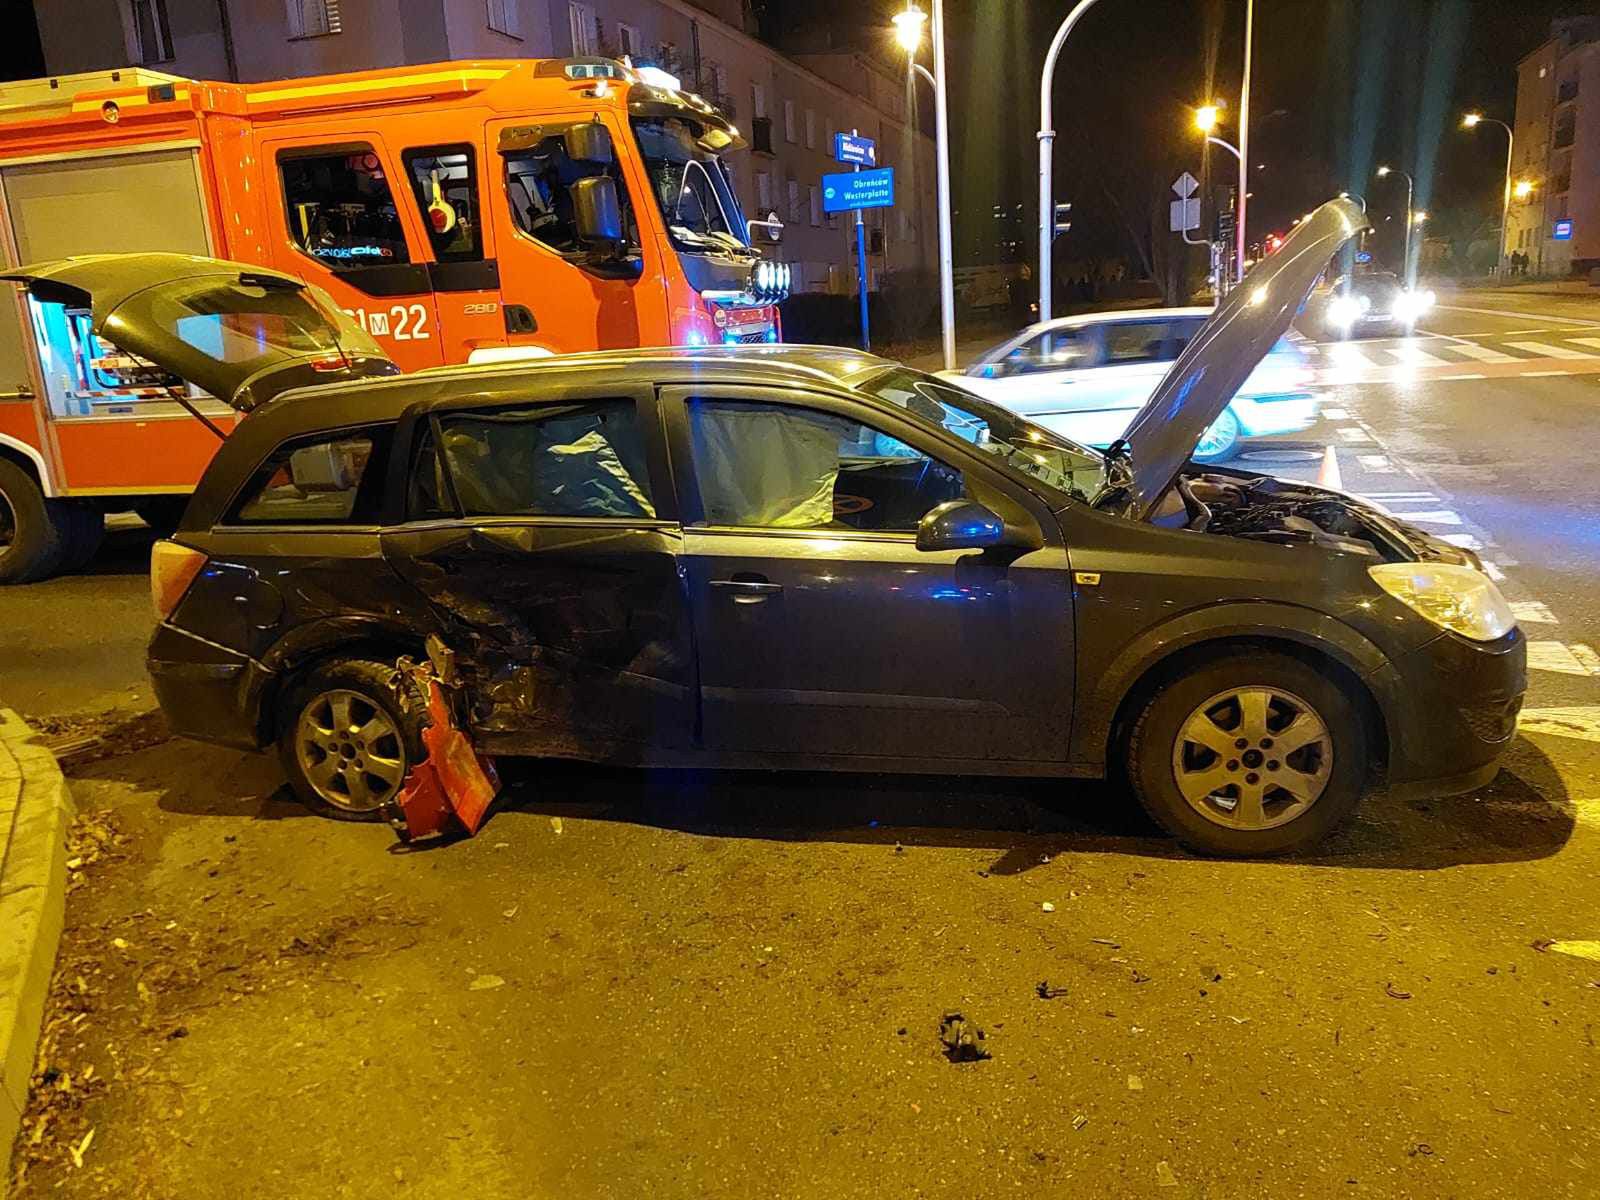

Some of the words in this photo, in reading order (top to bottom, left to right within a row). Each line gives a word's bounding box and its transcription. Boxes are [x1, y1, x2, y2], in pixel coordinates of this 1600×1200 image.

[463, 303, 498, 315] 280
[371, 315, 387, 334] M
[390, 304, 430, 341] 22
